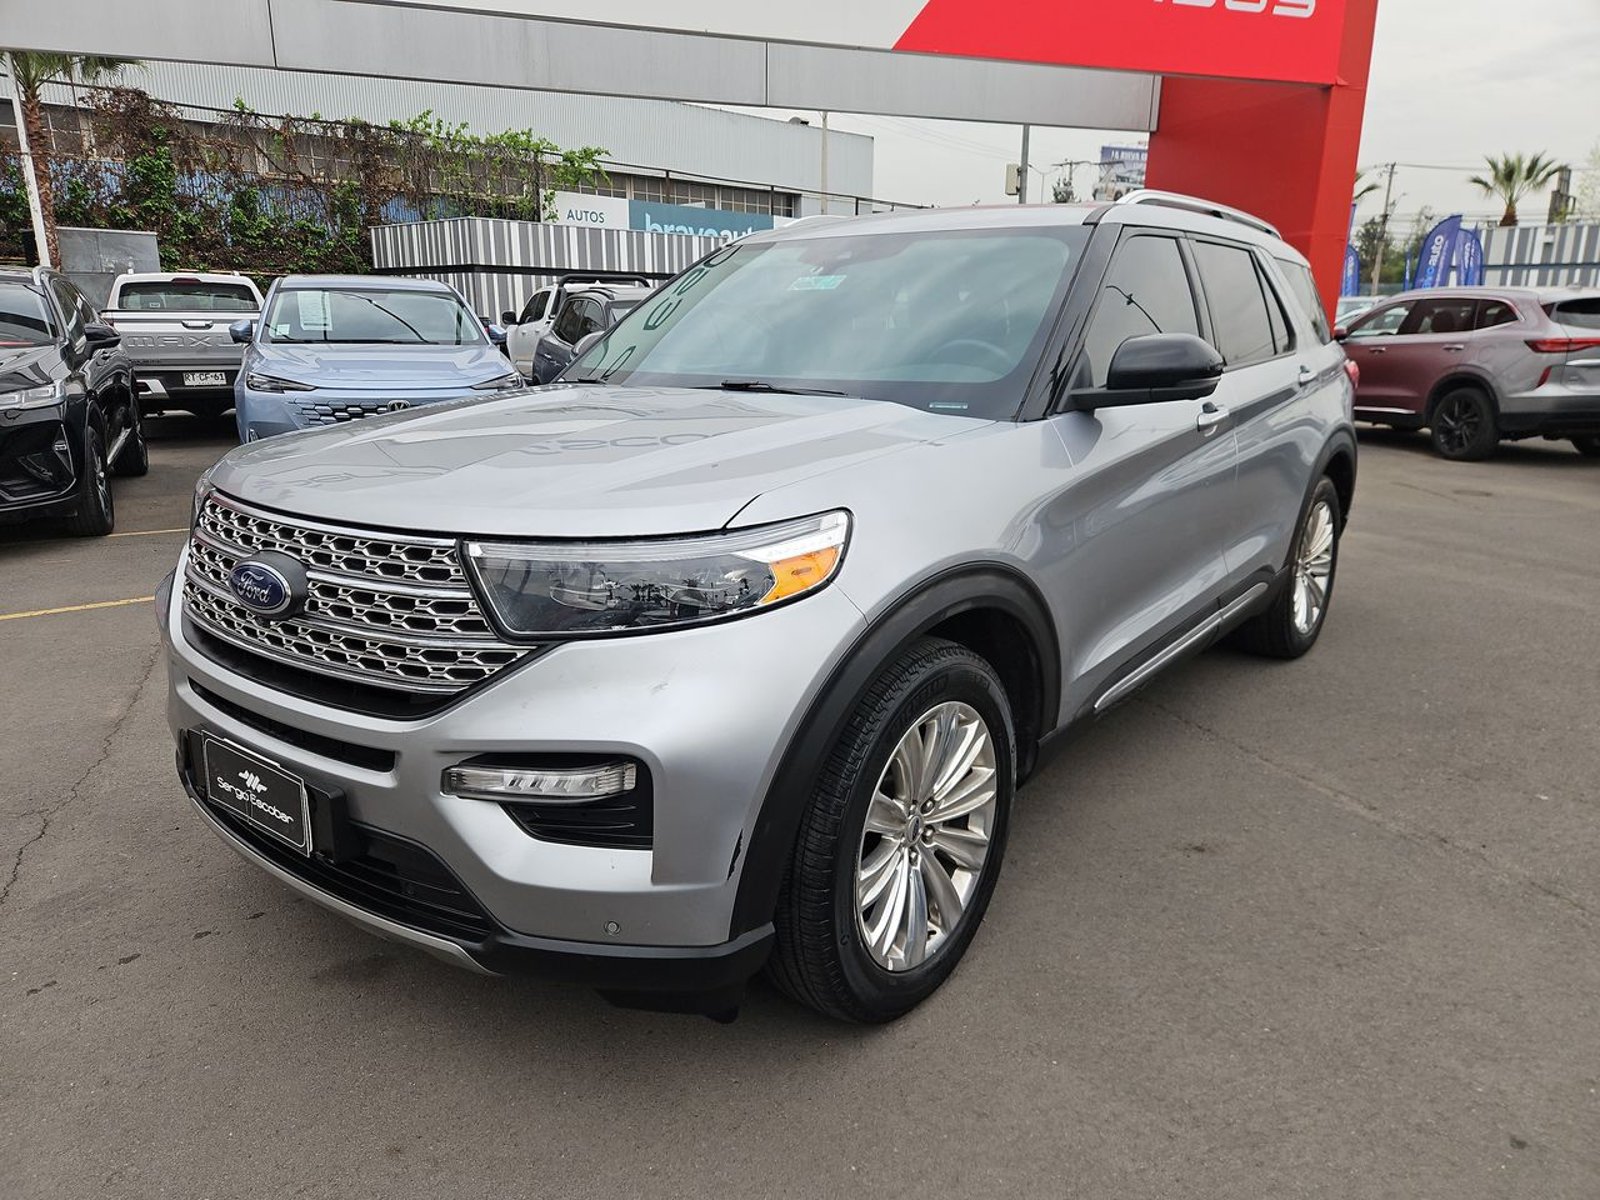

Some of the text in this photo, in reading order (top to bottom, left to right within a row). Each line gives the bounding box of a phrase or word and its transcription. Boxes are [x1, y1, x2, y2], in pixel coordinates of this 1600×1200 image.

[567, 209, 605, 223] AUTOS
[237, 570, 272, 604] Ford
[249, 793, 294, 824] Escobar
